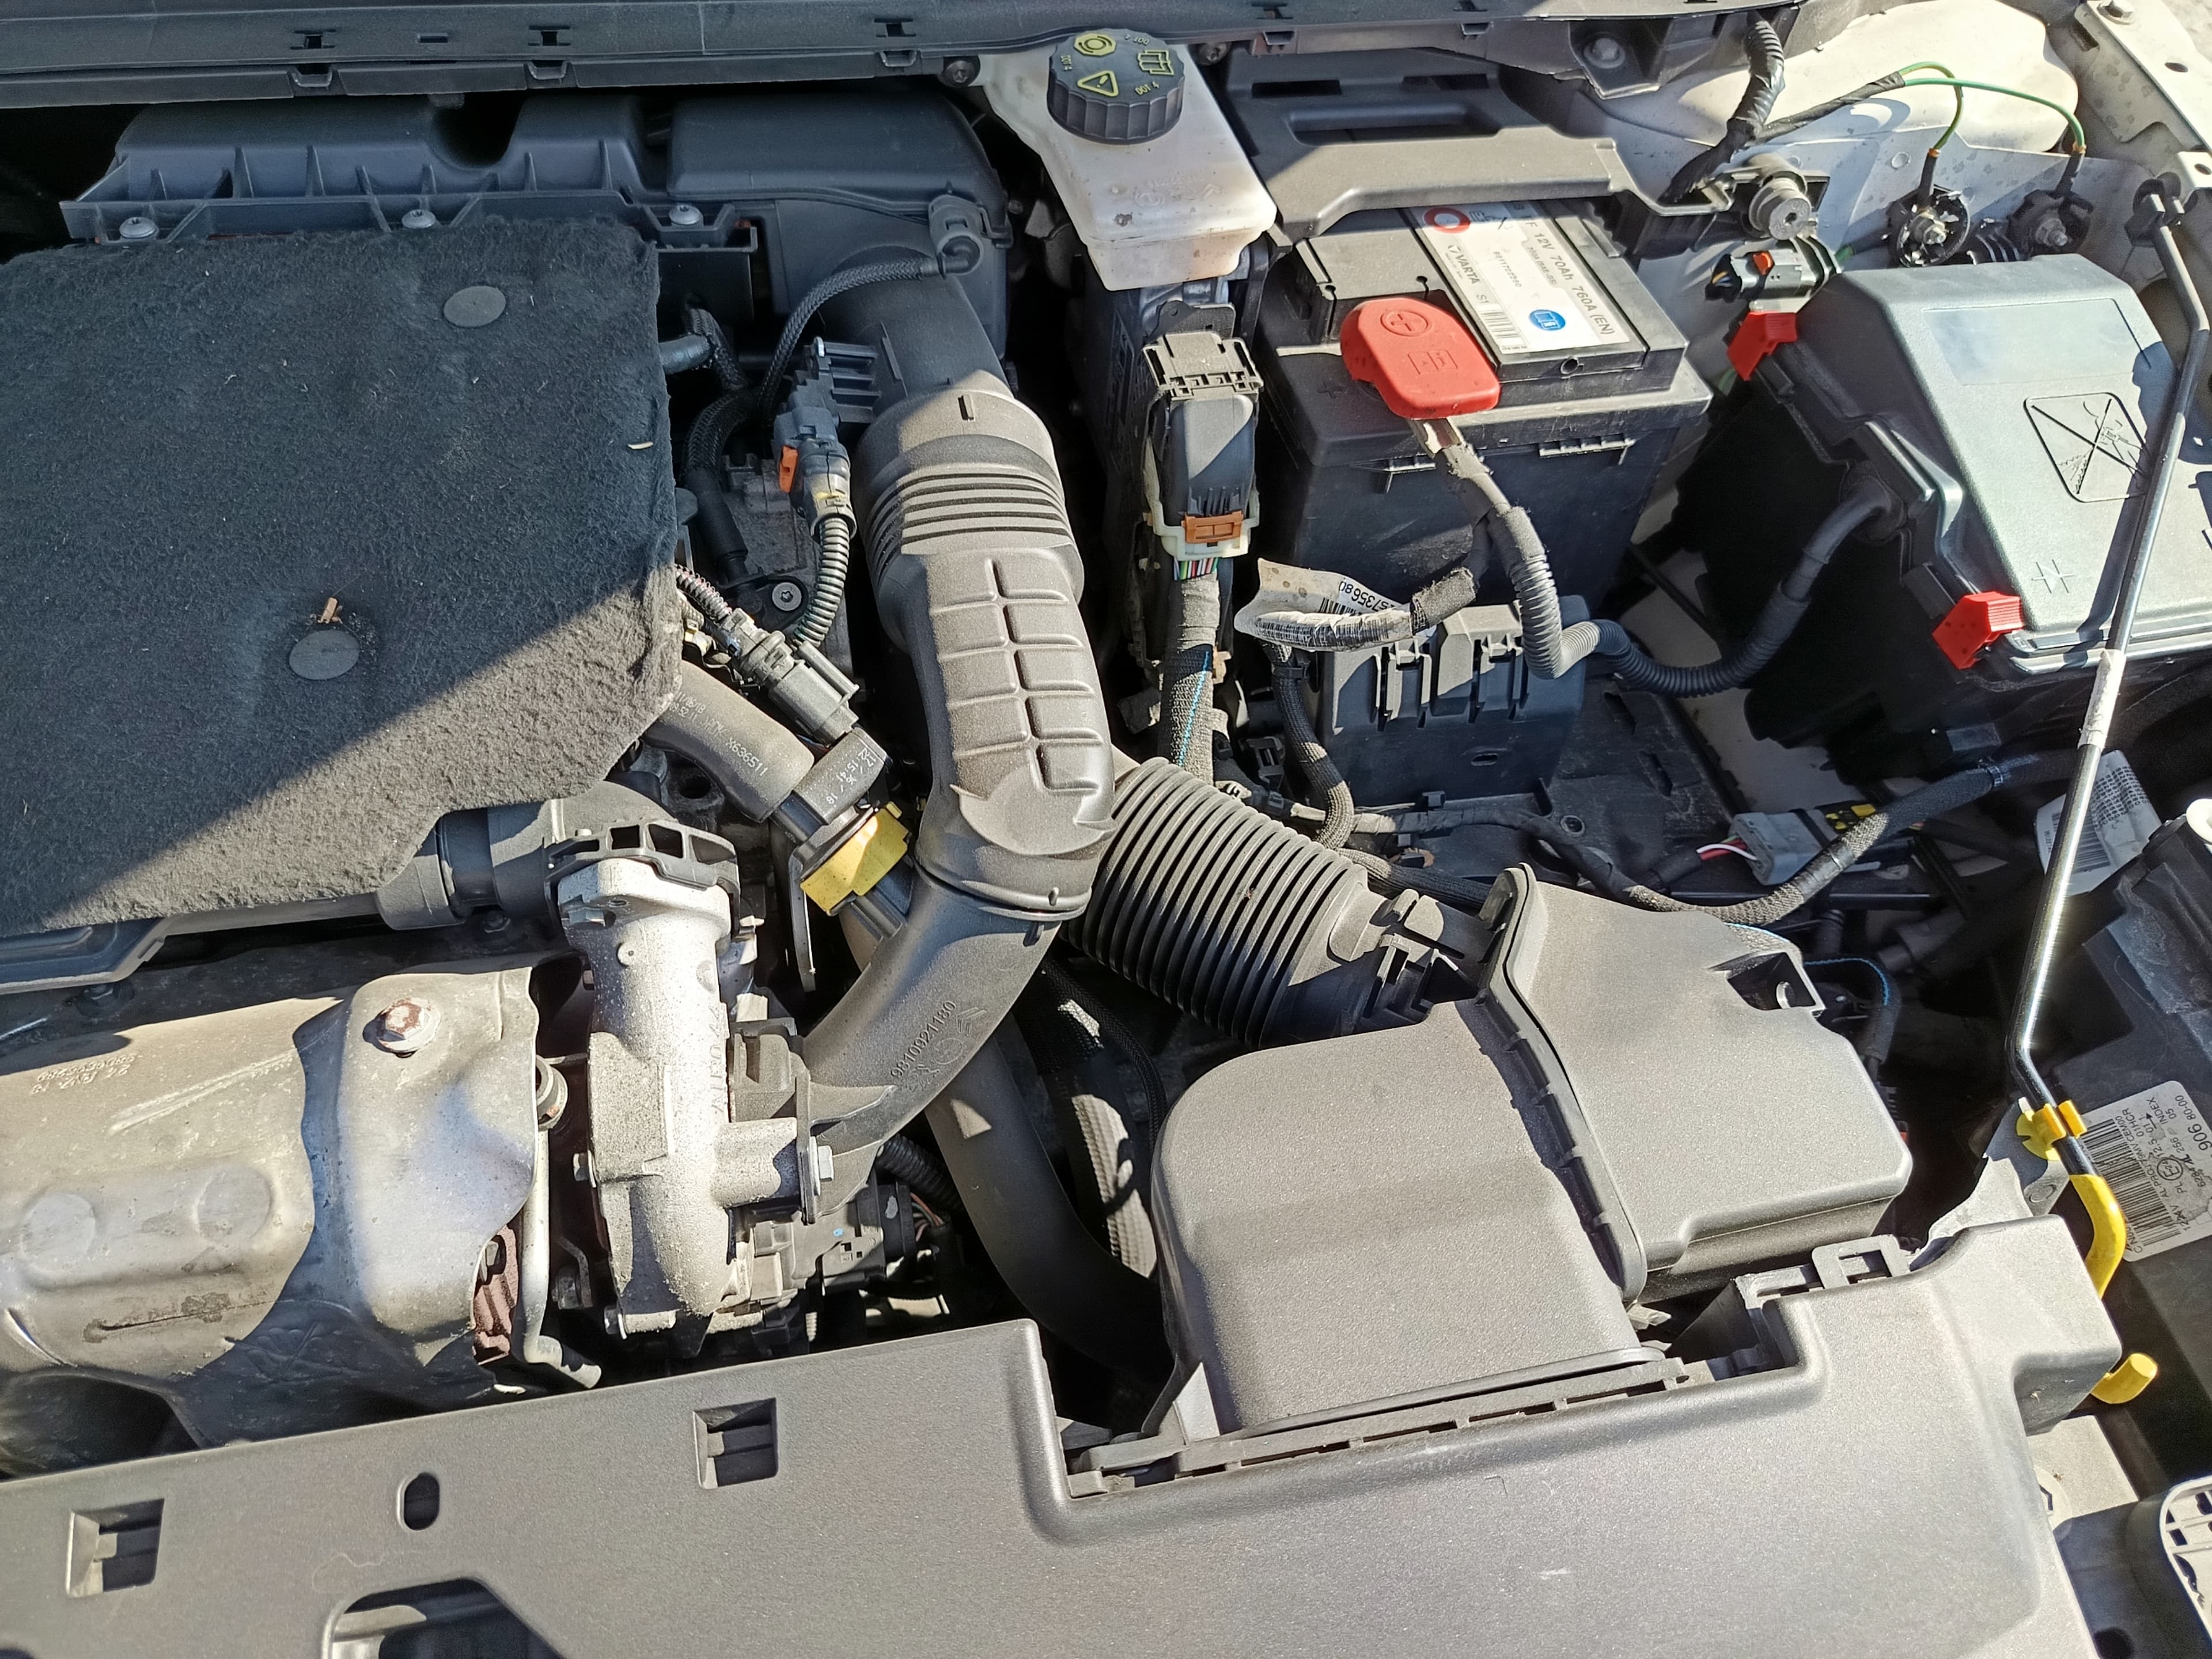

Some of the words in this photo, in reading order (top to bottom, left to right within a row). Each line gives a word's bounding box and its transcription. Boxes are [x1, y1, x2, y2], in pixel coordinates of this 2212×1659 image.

[1134, 37, 1150, 46] DOT
[1134, 84, 1151, 95] DOT
[1455, 252, 1480, 285] VARTA
[1533, 232, 1556, 251] 12V
[1550, 255, 1573, 281] 70Ah
[1571, 285, 1598, 317] 760A
[1593, 313, 1615, 336] (EN)
[1339, 581, 1397, 612] 5735680
[723, 737, 769, 777] X636511
[834, 748, 873, 782] 22:15:41
[890, 1000, 957, 1079] 9810921180
[2146, 1096, 2168, 1125] INDEX
[2165, 1107, 2177, 1120] 05
[2175, 1094, 2196, 1122] 80-00
[2115, 1115, 2135, 1142] CEM00
[2122, 1107, 2145, 1138] 01HCR
[2143, 1122, 2154, 1134] 01
[2148, 1137, 2165, 1158] 12,5
[2170, 1136, 2185, 1154] 256
[2187, 1122, 2212, 1153] 906
[2173, 1181, 2186, 1195] PL
